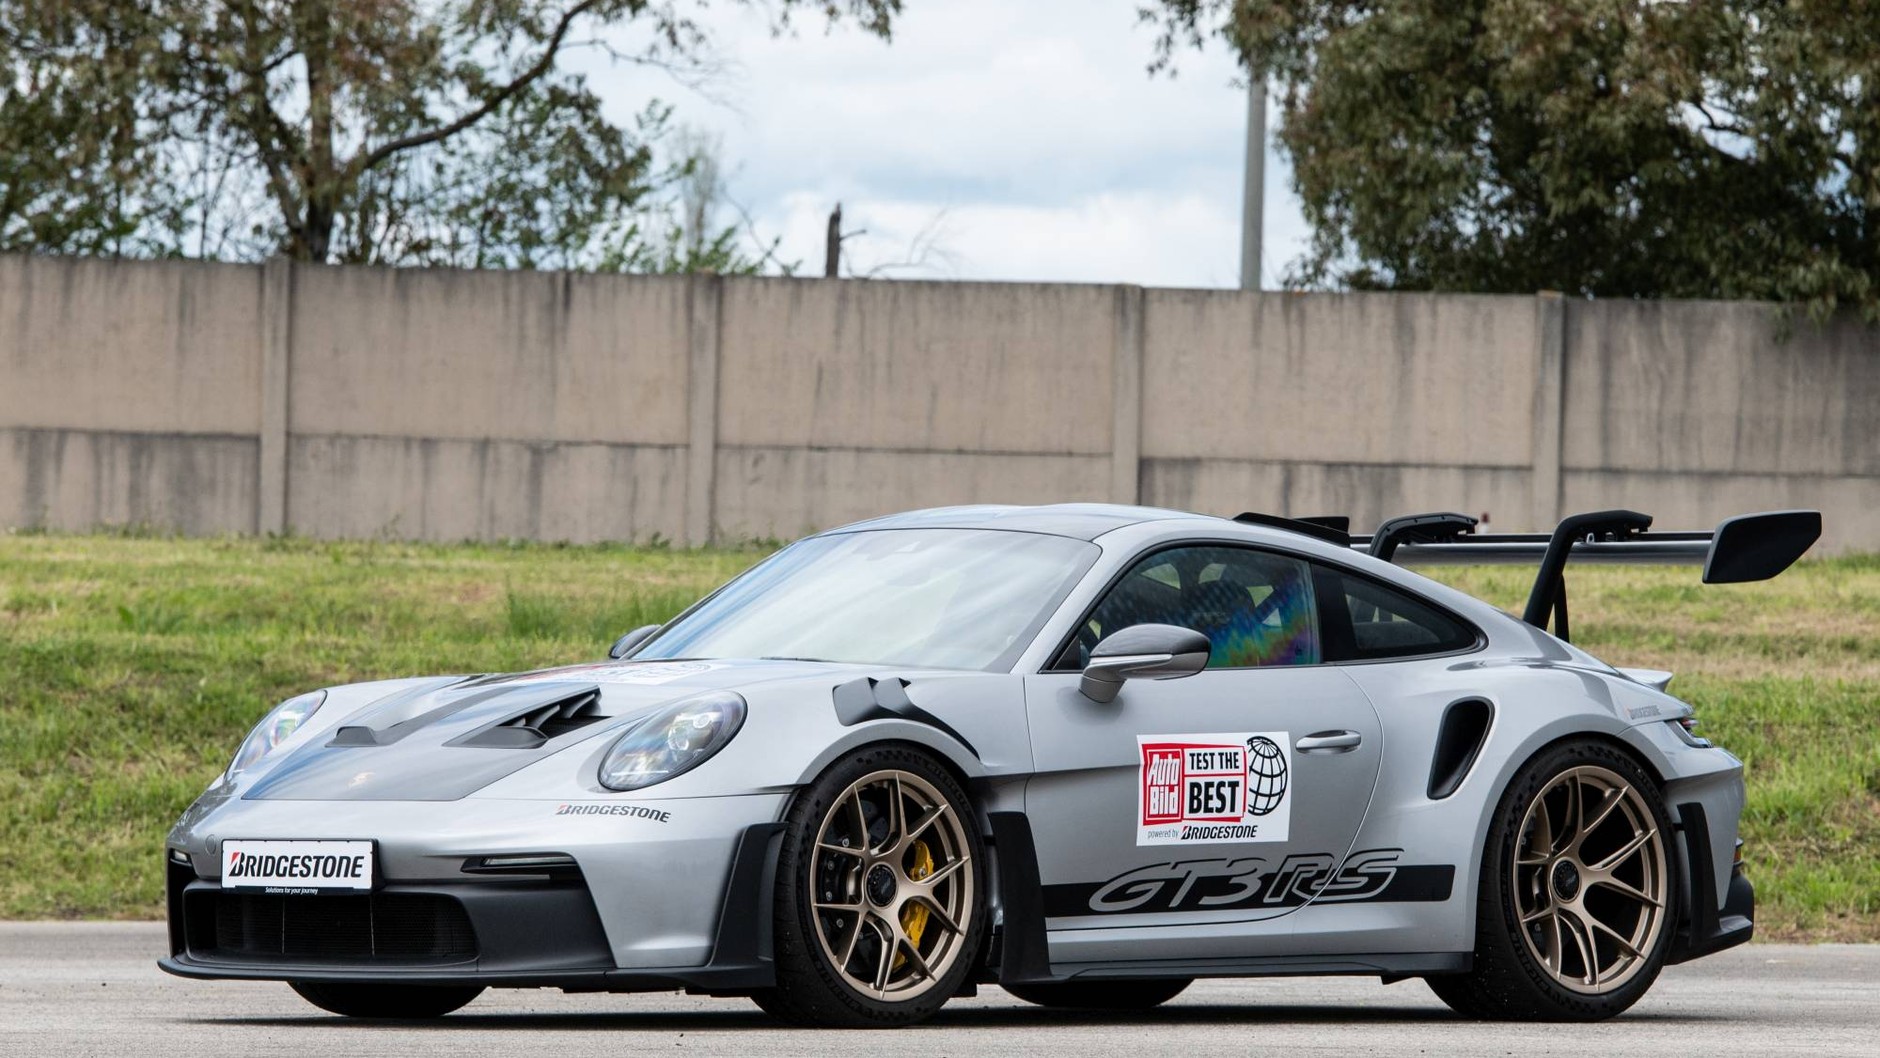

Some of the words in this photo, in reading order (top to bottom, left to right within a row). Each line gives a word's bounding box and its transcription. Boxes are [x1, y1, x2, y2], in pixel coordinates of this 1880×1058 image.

[1148, 753, 1181, 786] Auto
[1189, 752, 1215, 770] TEST
[1218, 752, 1240, 769] THE
[1149, 785, 1180, 815] Bild
[1189, 781, 1240, 814] BEST
[555, 804, 671, 823] BRIDGESTONE
[1147, 829, 1171, 839] powered
[1172, 828, 1179, 838] by
[1181, 825, 1258, 840] BRIDGESTONE
[228, 852, 364, 878] BRIDGESTONE
[301, 887, 318, 895] journey
